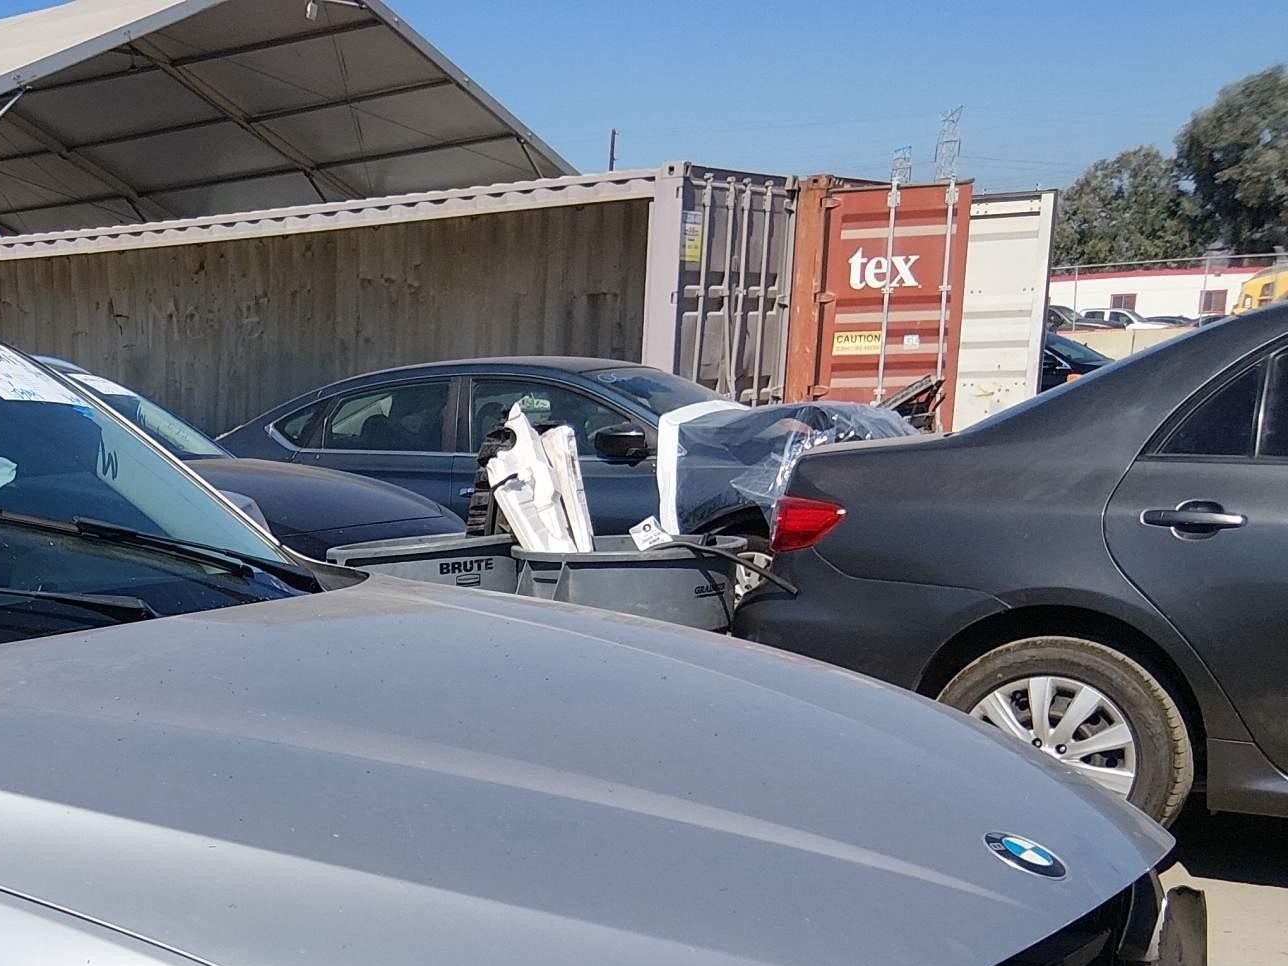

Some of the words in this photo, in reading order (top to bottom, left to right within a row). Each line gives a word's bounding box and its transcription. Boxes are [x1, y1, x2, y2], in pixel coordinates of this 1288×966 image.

[848, 247, 920, 290] tex
[836, 334, 881, 344] CAUTION
[439, 557, 494, 575] BRUTE
